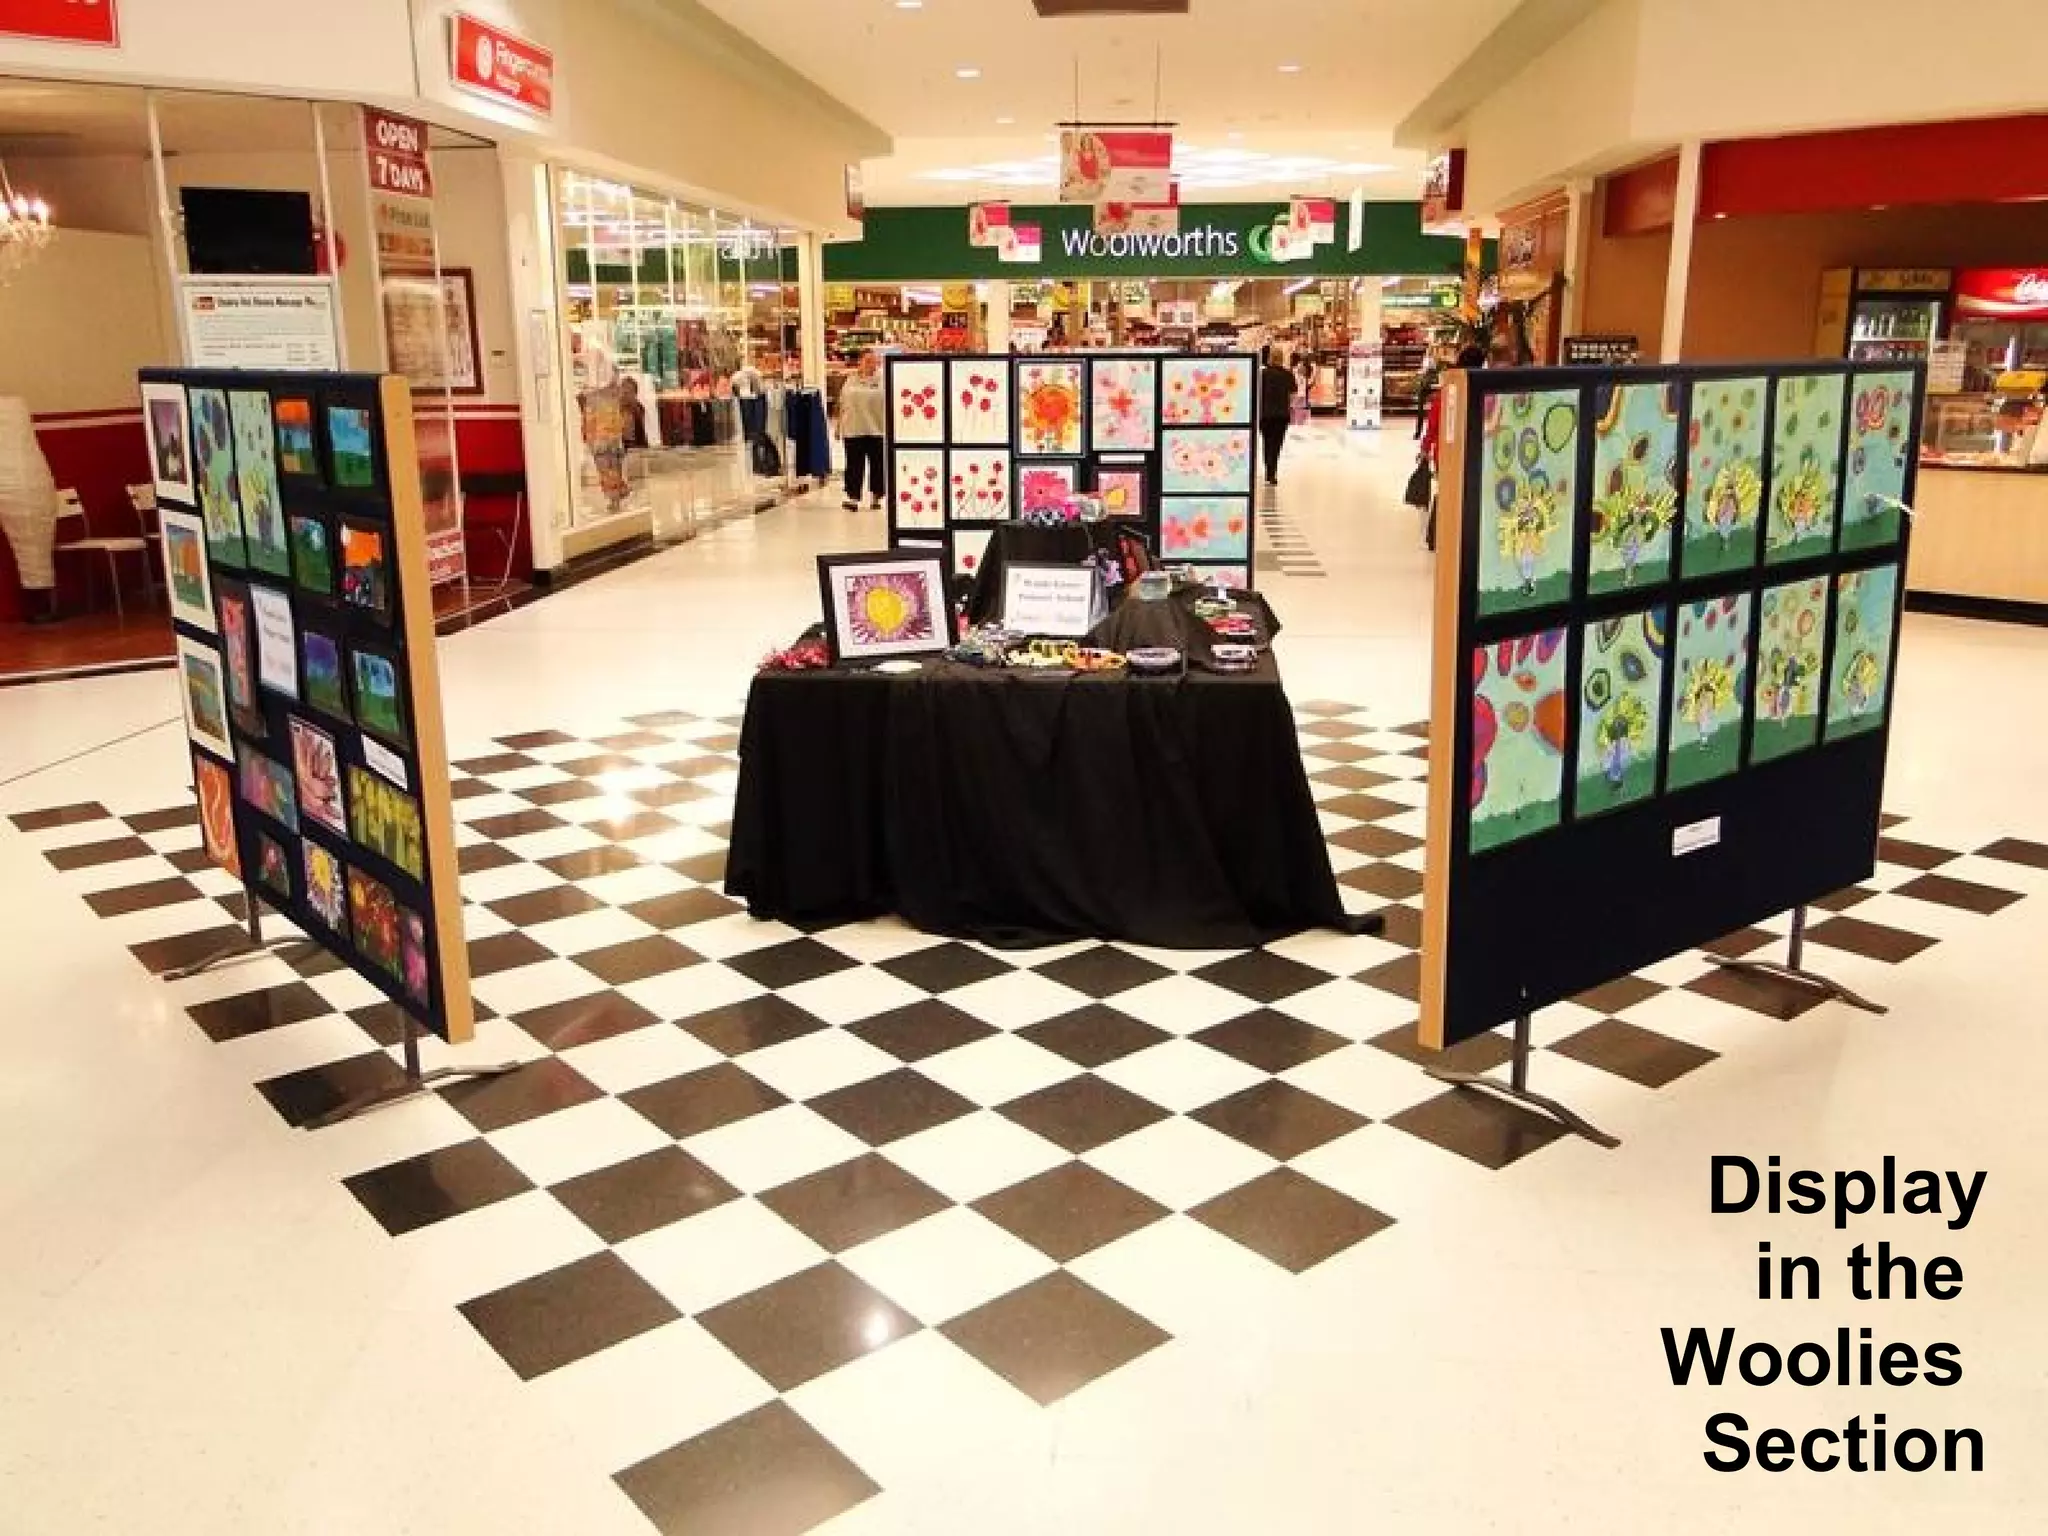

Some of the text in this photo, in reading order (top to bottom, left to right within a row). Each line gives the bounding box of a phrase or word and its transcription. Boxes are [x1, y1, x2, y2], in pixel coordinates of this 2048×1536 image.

[375, 119, 418, 151] OPEN
[375, 155, 424, 193] 7 DAYS
[1061, 224, 1239, 258] Woolworths
